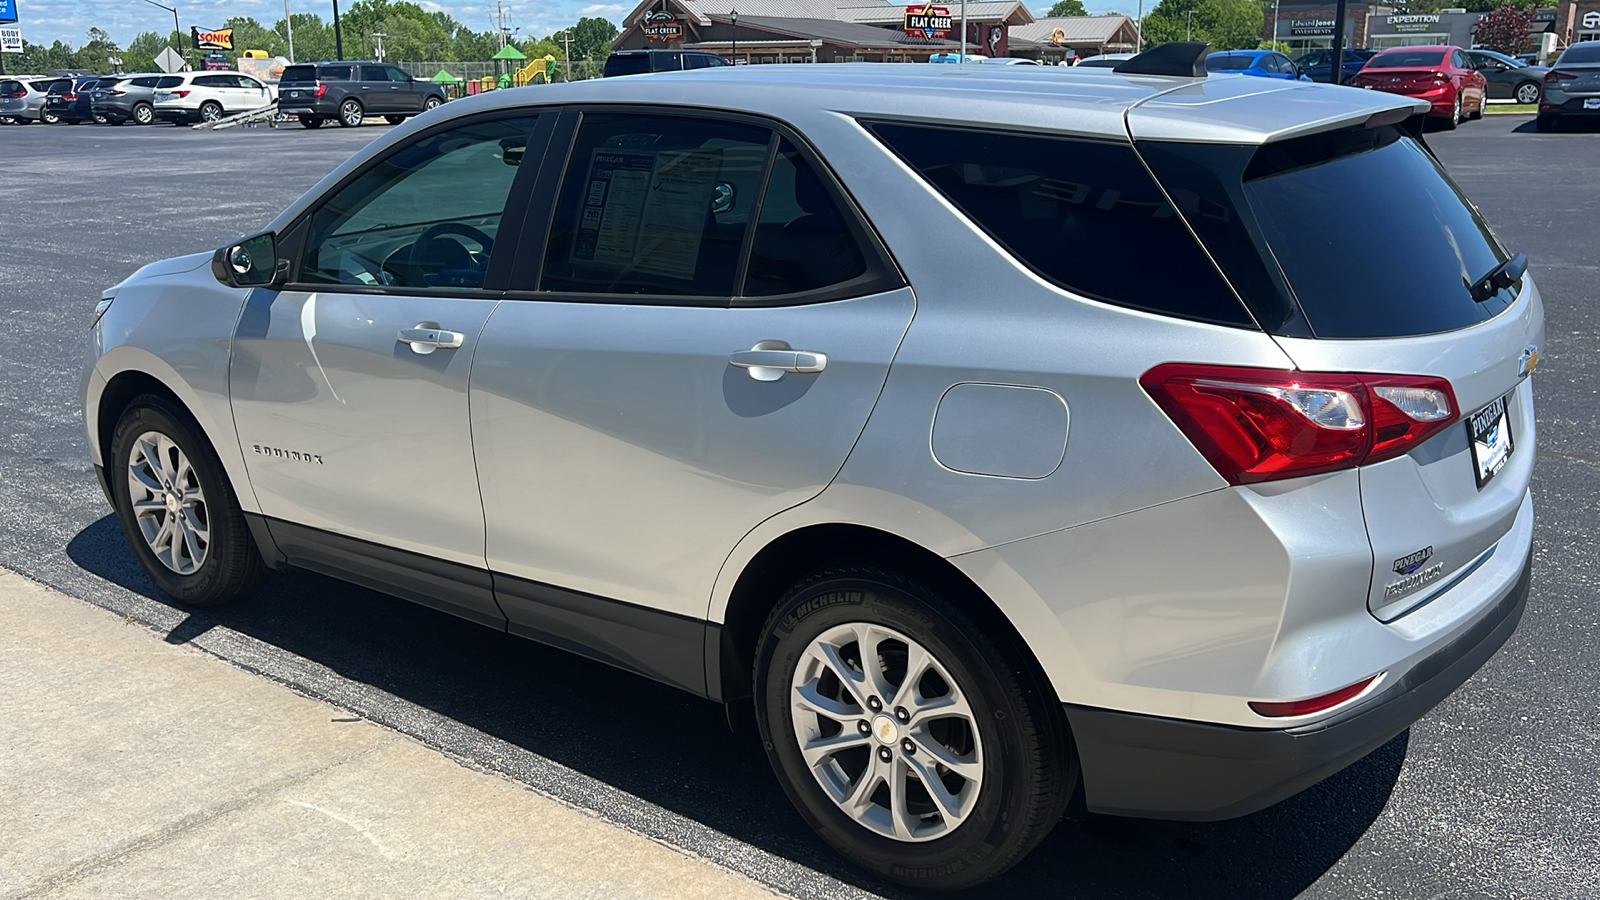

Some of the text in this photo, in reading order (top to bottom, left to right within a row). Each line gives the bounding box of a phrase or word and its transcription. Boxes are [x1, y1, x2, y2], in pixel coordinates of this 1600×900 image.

[911, 16, 951, 28] FLAT CREEK
[1387, 15, 1440, 24] EXPEDITION
[199, 33, 230, 43] SONIC
[595, 155, 624, 164] PINEGAR
[1472, 397, 1504, 438] PINEGAR
[252, 444, 323, 465] EQUINOX
[1394, 546, 1433, 571] PINEGAR
[796, 591, 861, 619] MICHELIN
